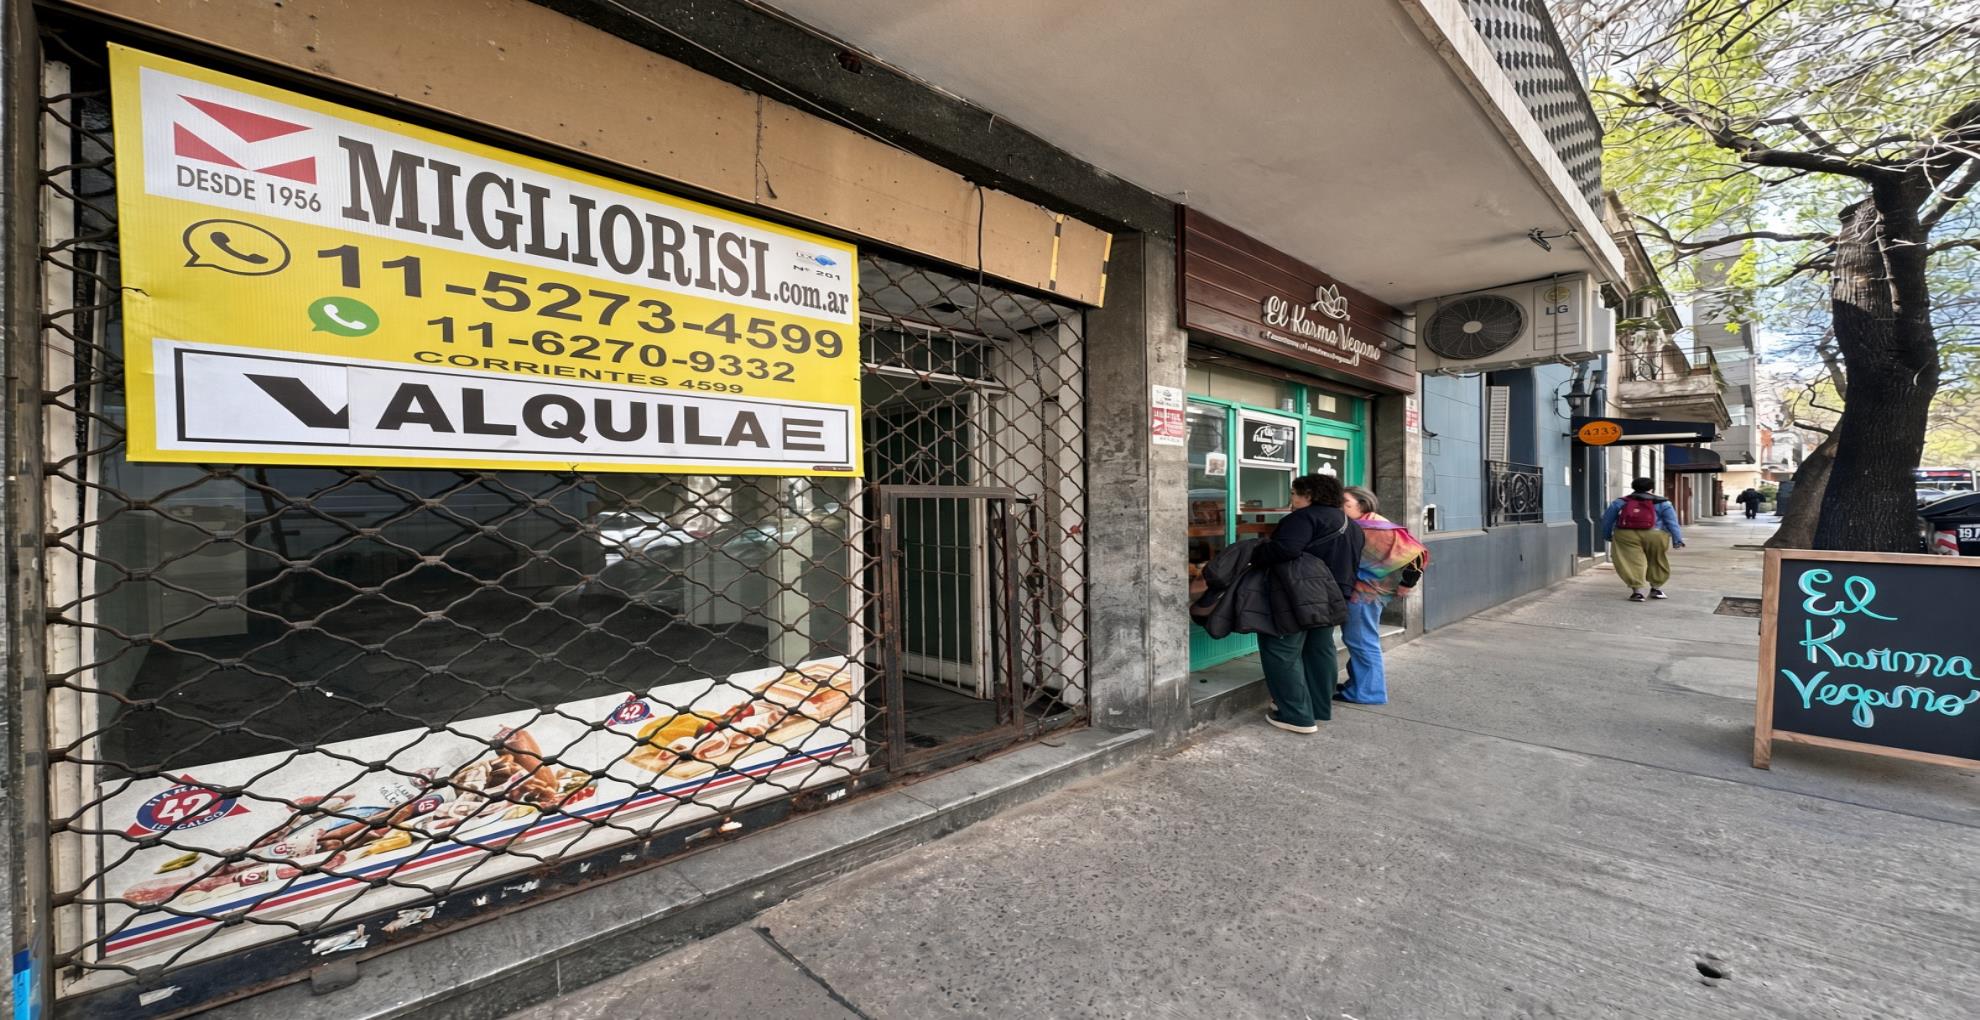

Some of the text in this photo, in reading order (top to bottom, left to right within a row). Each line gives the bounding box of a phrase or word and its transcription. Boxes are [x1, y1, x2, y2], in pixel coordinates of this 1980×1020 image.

[177, 164, 321, 213] DESDE 1956
[317, 244, 844, 358] 11-5273-4599
[816, 270, 841, 281] 201
[1264, 295, 1289, 327] El
[1291, 304, 1338, 345] Karma
[1338, 322, 1380, 366] Vegano
[1546, 304, 1568, 316] LG
[413, 350, 744, 394] CORRIENTES 4599
[427, 316, 795, 383] 11-6270-9332
[1798, 568, 1898, 621] El
[1799, 618, 1980, 681] Karma
[620, 704, 641, 720] 42
[1781, 669, 1980, 728] Vegano
[156, 792, 213, 822] 42
